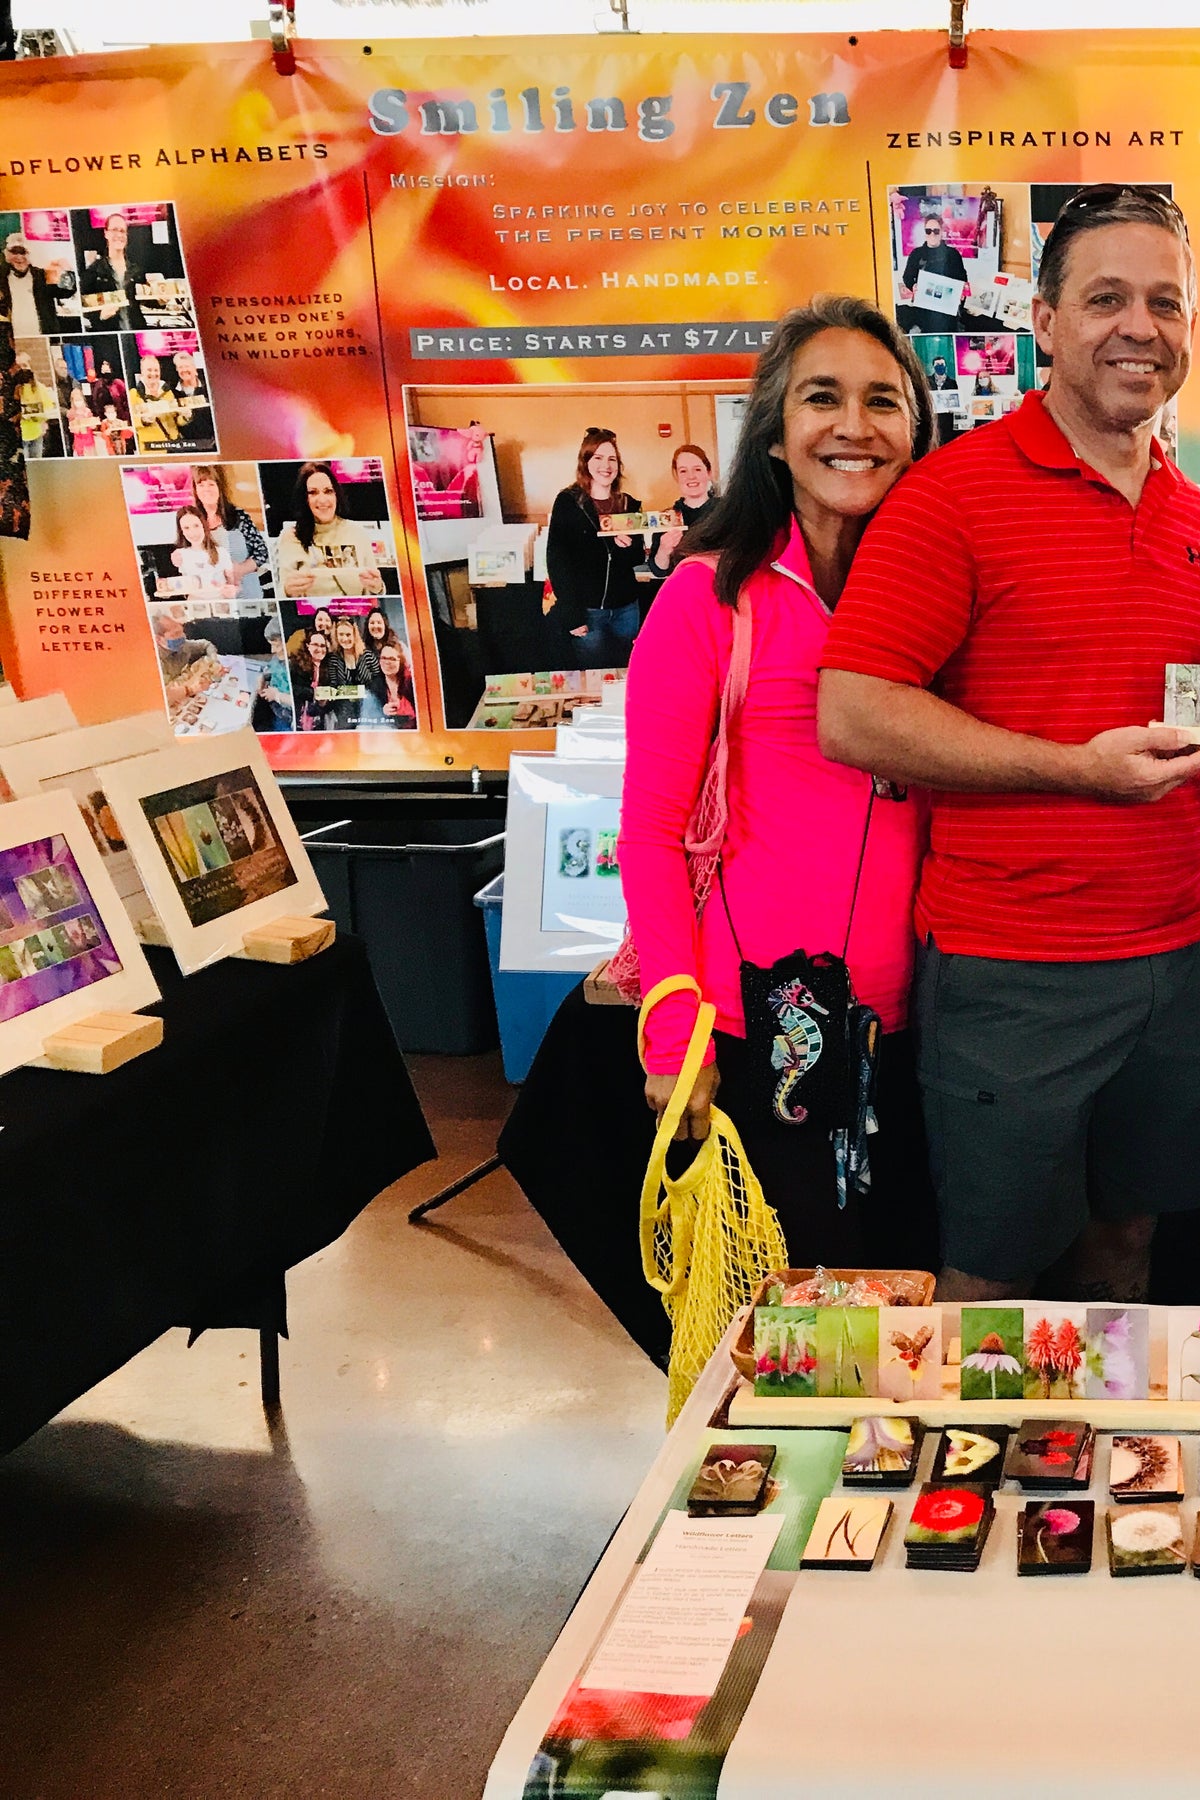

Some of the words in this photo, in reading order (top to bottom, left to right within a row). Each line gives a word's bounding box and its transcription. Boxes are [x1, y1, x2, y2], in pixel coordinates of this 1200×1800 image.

[368, 86, 676, 142] Smiling
[712, 81, 851, 129] Zen
[886, 130, 1112, 149] ZENSPIRATION
[1128, 130, 1184, 147] ART
[155, 143, 328, 166] ALPHABETS
[390, 173, 496, 188] MISSION:
[492, 203, 616, 219] SPARKING
[627, 203, 668, 217] JOY
[680, 202, 709, 216] TO
[719, 199, 861, 215] CELEBRATE
[494, 229, 552, 244] THE
[567, 226, 706, 242] PRESENT
[721, 222, 850, 239] MOMENT
[489, 274, 588, 292] LOCAL.
[602, 271, 769, 289] HANDMADE.
[211, 293, 343, 308] PERSONALIZED
[215, 316, 225, 326] A
[234, 313, 291, 325] LOVED
[297, 310, 345, 323] ONE'S
[218, 332, 268, 343] NAME
[275, 331, 298, 341] OR
[305, 328, 362, 340] YOURS,
[416, 334, 513, 353] PRICE:
[525, 333, 627, 351] STARTS
[640, 333, 671, 349] AT
[221, 350, 239, 361] IN
[247, 345, 374, 360] WILDFLOWERS.
[30, 571, 94, 583] SELECT
[102, 571, 113, 581] A
[33, 588, 128, 600] DIFFERENT
[36, 607, 105, 618] FLOWER
[38, 624, 71, 635] FOR
[79, 623, 125, 634] EACH
[41, 641, 112, 652] LETTER.
